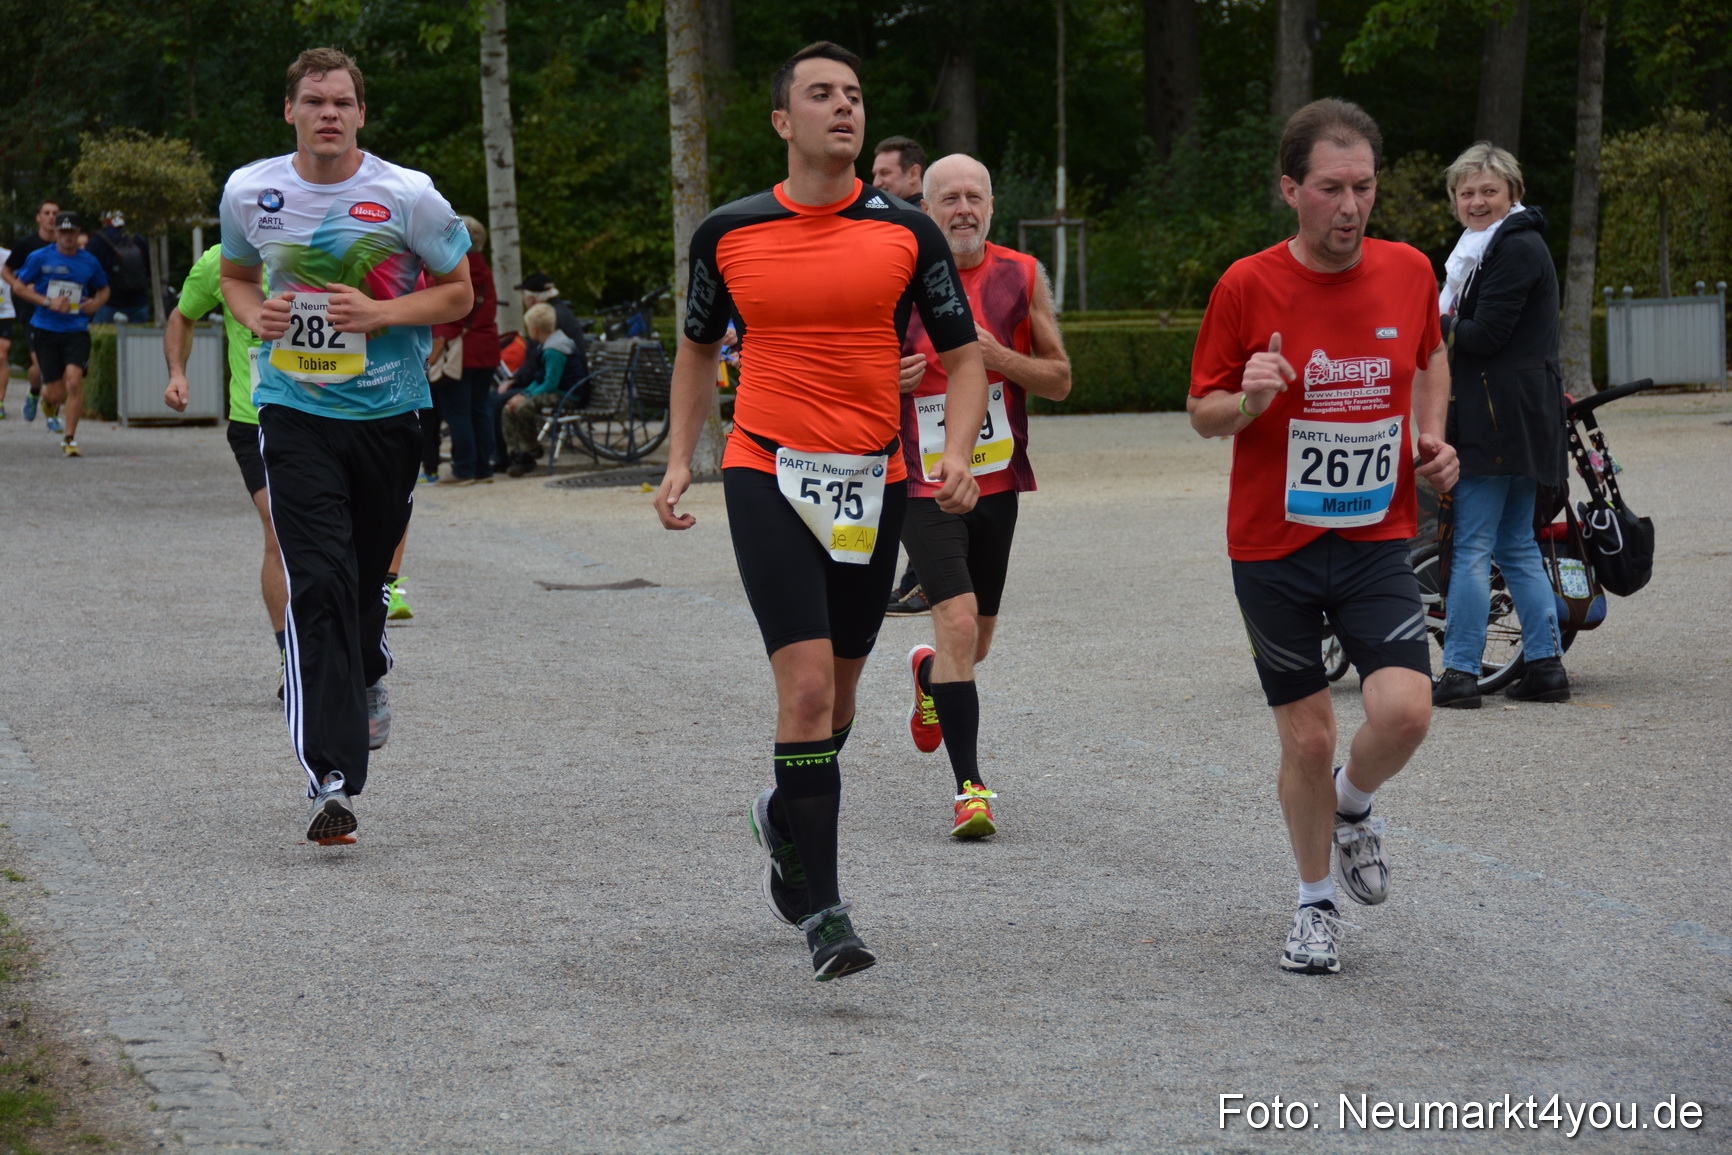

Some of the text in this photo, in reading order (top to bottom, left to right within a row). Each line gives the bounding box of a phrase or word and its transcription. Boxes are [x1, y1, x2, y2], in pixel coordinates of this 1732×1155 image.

[258, 216, 284, 225] PARTL
[290, 314, 346, 349] 282
[297, 356, 337, 371] Tobias
[357, 371, 395, 387] Stadtlauf
[1306, 387, 1389, 399] www.helpi.com
[1312, 400, 1343, 408] Ausrüstung
[1291, 430, 1386, 443] PARTL Neumarkt
[779, 456, 819, 473] PARTL
[1300, 443, 1391, 488] 2676
[800, 477, 864, 521] 535
[1322, 497, 1371, 513] Martin
